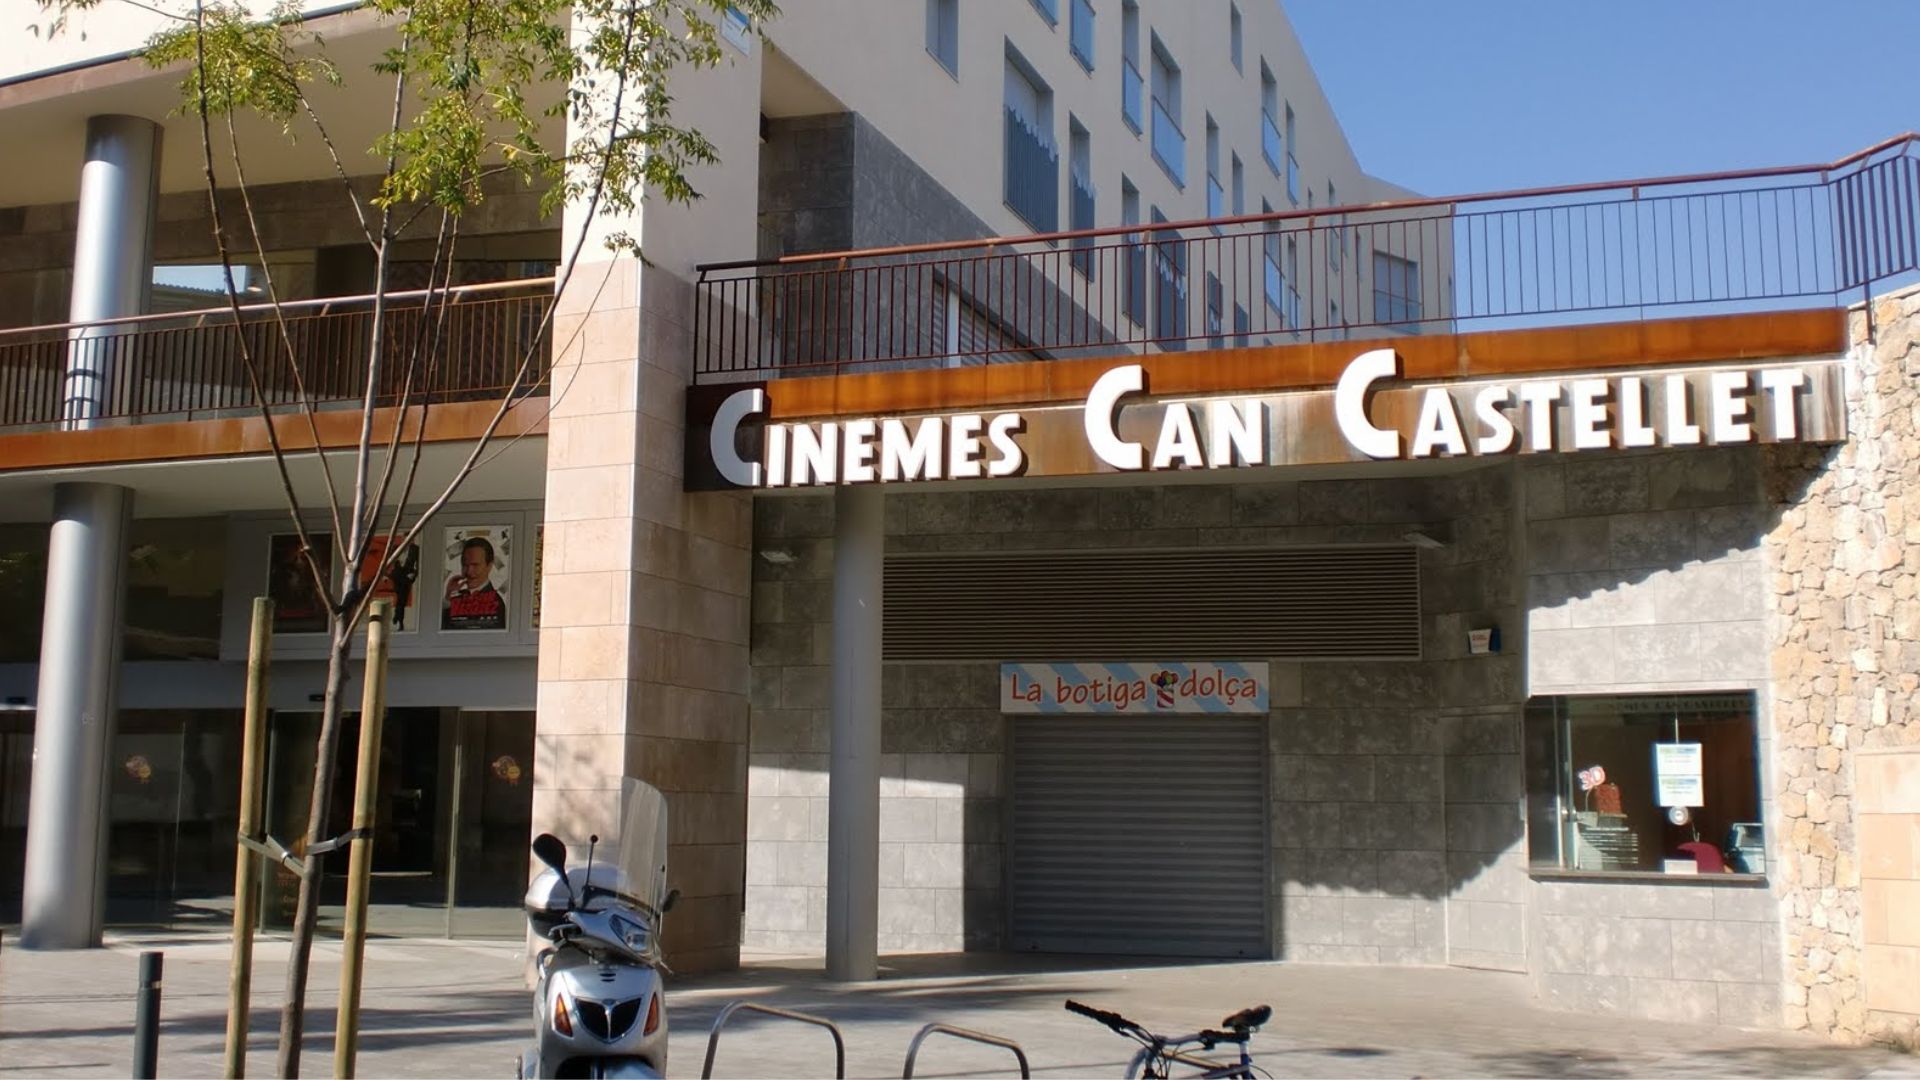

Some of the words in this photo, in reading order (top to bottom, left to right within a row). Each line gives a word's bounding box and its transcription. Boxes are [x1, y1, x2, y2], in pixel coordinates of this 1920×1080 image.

[710, 388, 1021, 486] CINEMES
[1084, 364, 1263, 470] CAN
[1335, 348, 1804, 458] CASTELLET
[1012, 674, 1041, 702] La
[1056, 676, 1146, 710] botiga
[1180, 669, 1257, 705] dolça
[1578, 766, 1606, 791] 3D
